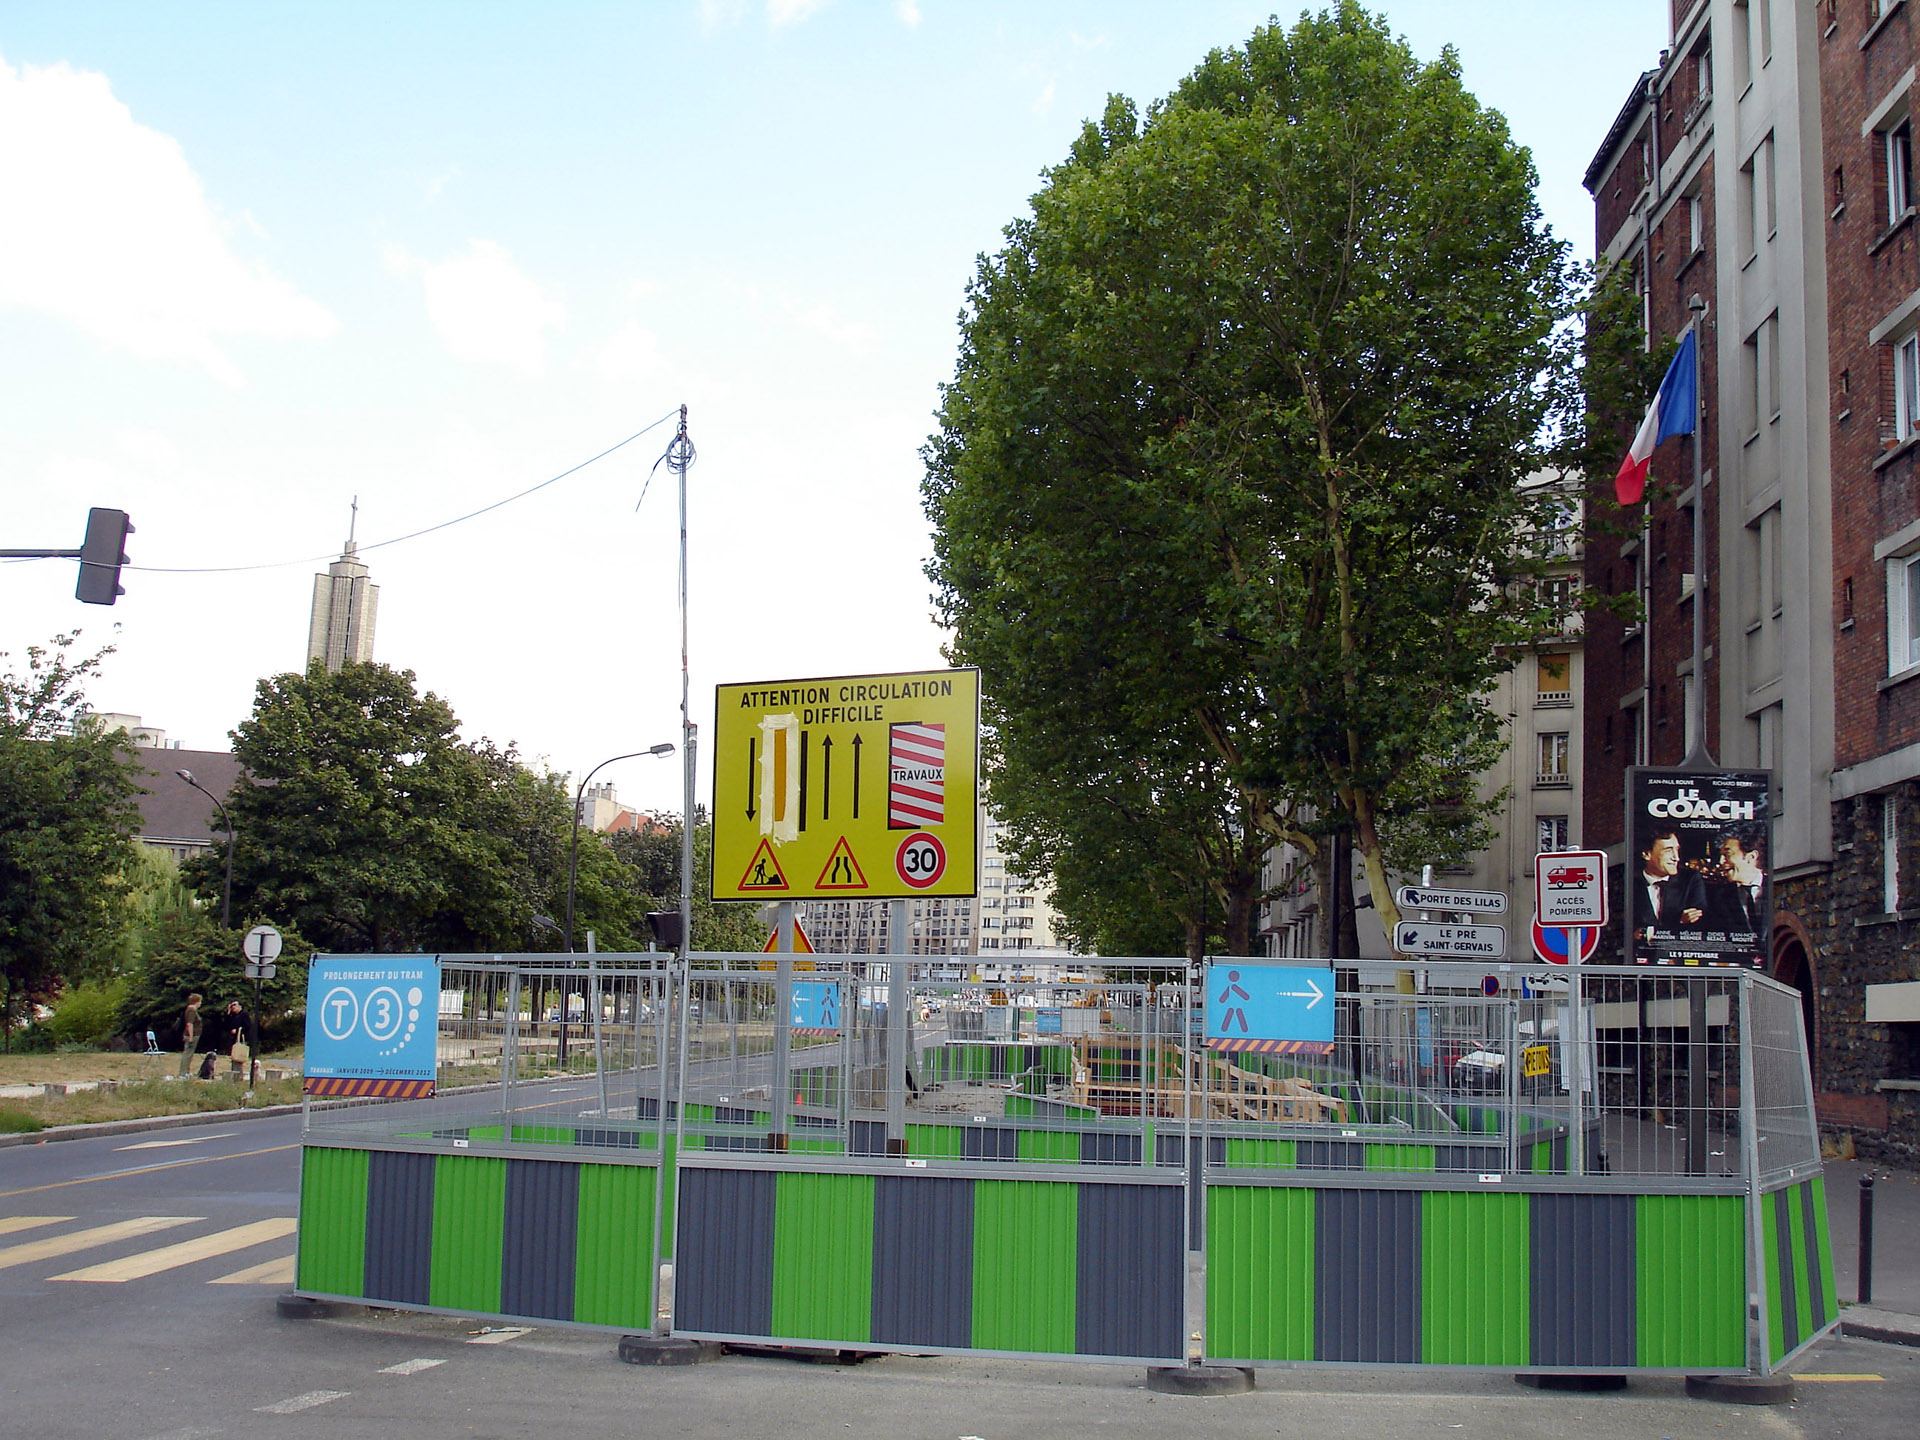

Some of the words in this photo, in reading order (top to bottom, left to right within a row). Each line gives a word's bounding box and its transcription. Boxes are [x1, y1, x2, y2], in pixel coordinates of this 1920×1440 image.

[741, 688, 830, 708] ATTENTION
[840, 680, 952, 702] CIRCULATION
[803, 705, 883, 724] DIFFICILE
[893, 768, 943, 781] TRAVAUX
[1678, 789, 1700, 800] LE
[1648, 798, 1754, 820] COACH
[906, 848, 937, 873] 30
[1420, 894, 1450, 905] PORTE
[1454, 896, 1472, 906] DES
[1475, 897, 1501, 908] LILAS
[1549, 907, 1592, 916] POMPIERS
[1440, 929, 1452, 938] LE
[1457, 929, 1477, 939] PRÉ
[1423, 940, 1493, 952] SAINT-GERVAIS
[323, 971, 386, 981] PROLONGEMENT
[387, 970, 398, 980] DU
[401, 970, 423, 979] TRAM
[331, 1000, 349, 1030] T
[374, 998, 390, 1029] 3
